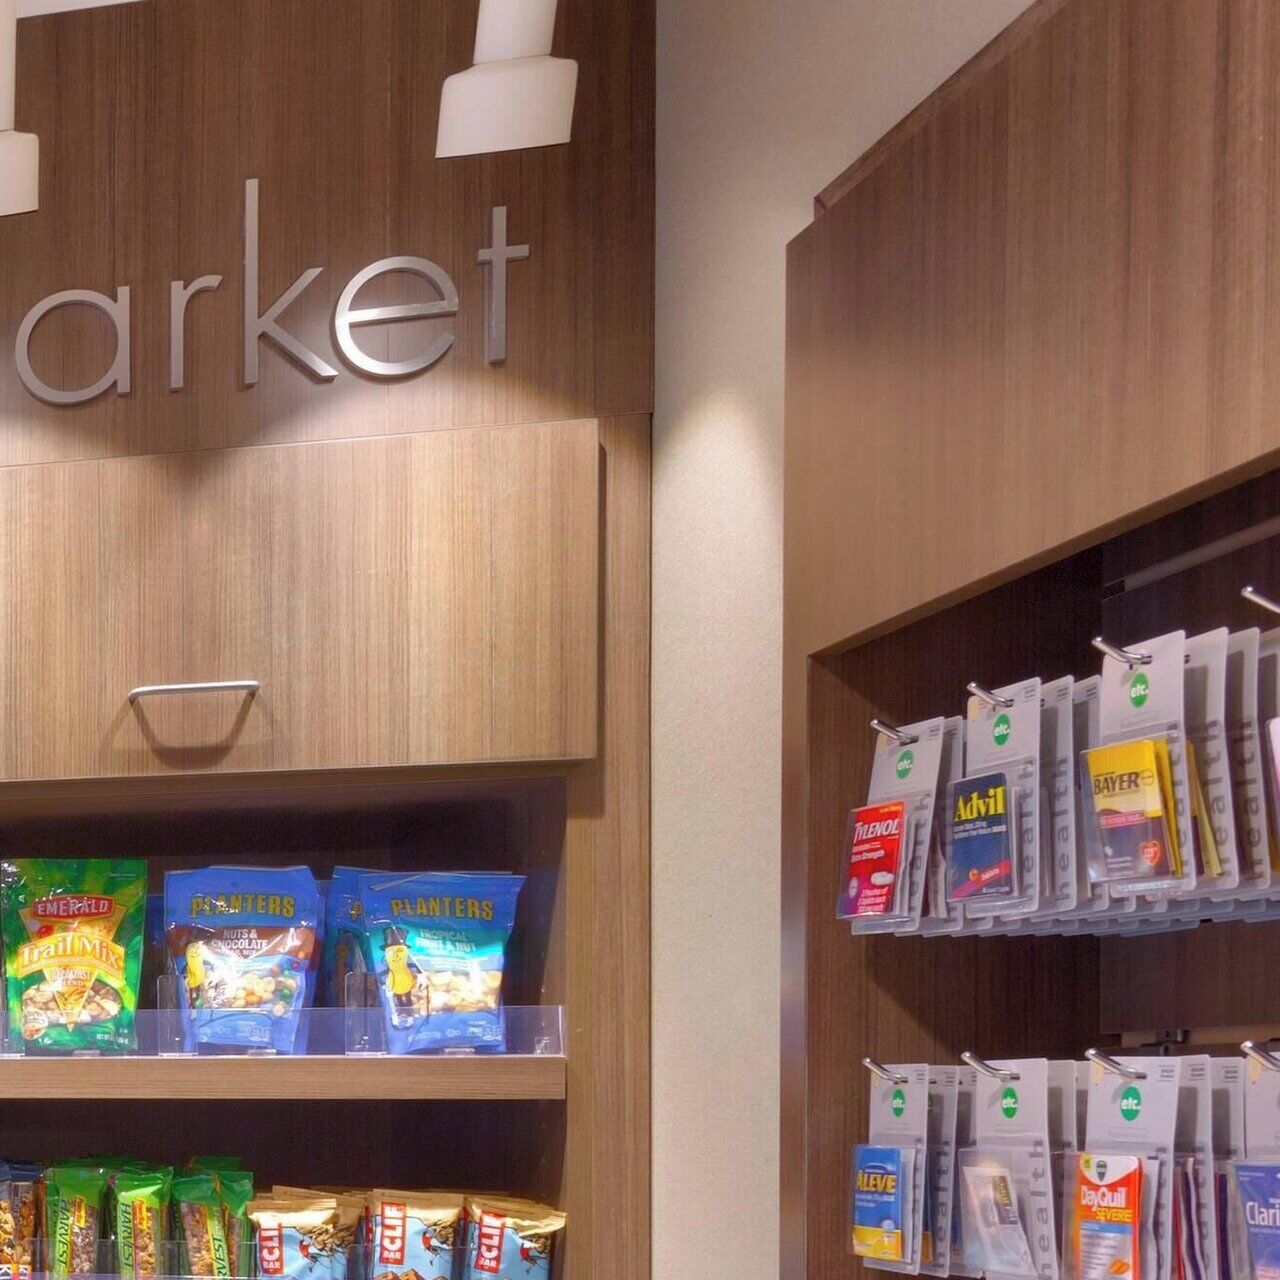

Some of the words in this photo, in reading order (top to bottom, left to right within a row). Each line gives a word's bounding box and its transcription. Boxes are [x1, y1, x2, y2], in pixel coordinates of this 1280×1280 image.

[1130, 683, 1149, 698] etc.
[994, 723, 1011, 736] etc.
[1094, 771, 1140, 795] BAYER
[955, 785, 1007, 821] Advil
[854, 820, 900, 841] TYLENOL
[37, 900, 108, 914] EMERALD
[191, 895, 296, 918] PLANTERS
[392, 898, 494, 921] PLANTERS
[223, 930, 246, 939] NUTS
[22, 935, 74, 965] Trail
[77, 935, 118, 966] Mix
[1002, 1097, 1018, 1109] etc.
[1121, 1096, 1142, 1112] etc.
[856, 1168, 896, 1194] ALEVE
[1080, 1186, 1127, 1209] DayQuil
[1095, 1208, 1133, 1222] SEVERE
[56, 1199, 72, 1269] HARVEST
[120, 1202, 133, 1270] HARVEST
[382, 1204, 404, 1251] CLIF
[382, 1250, 402, 1260] BAR
